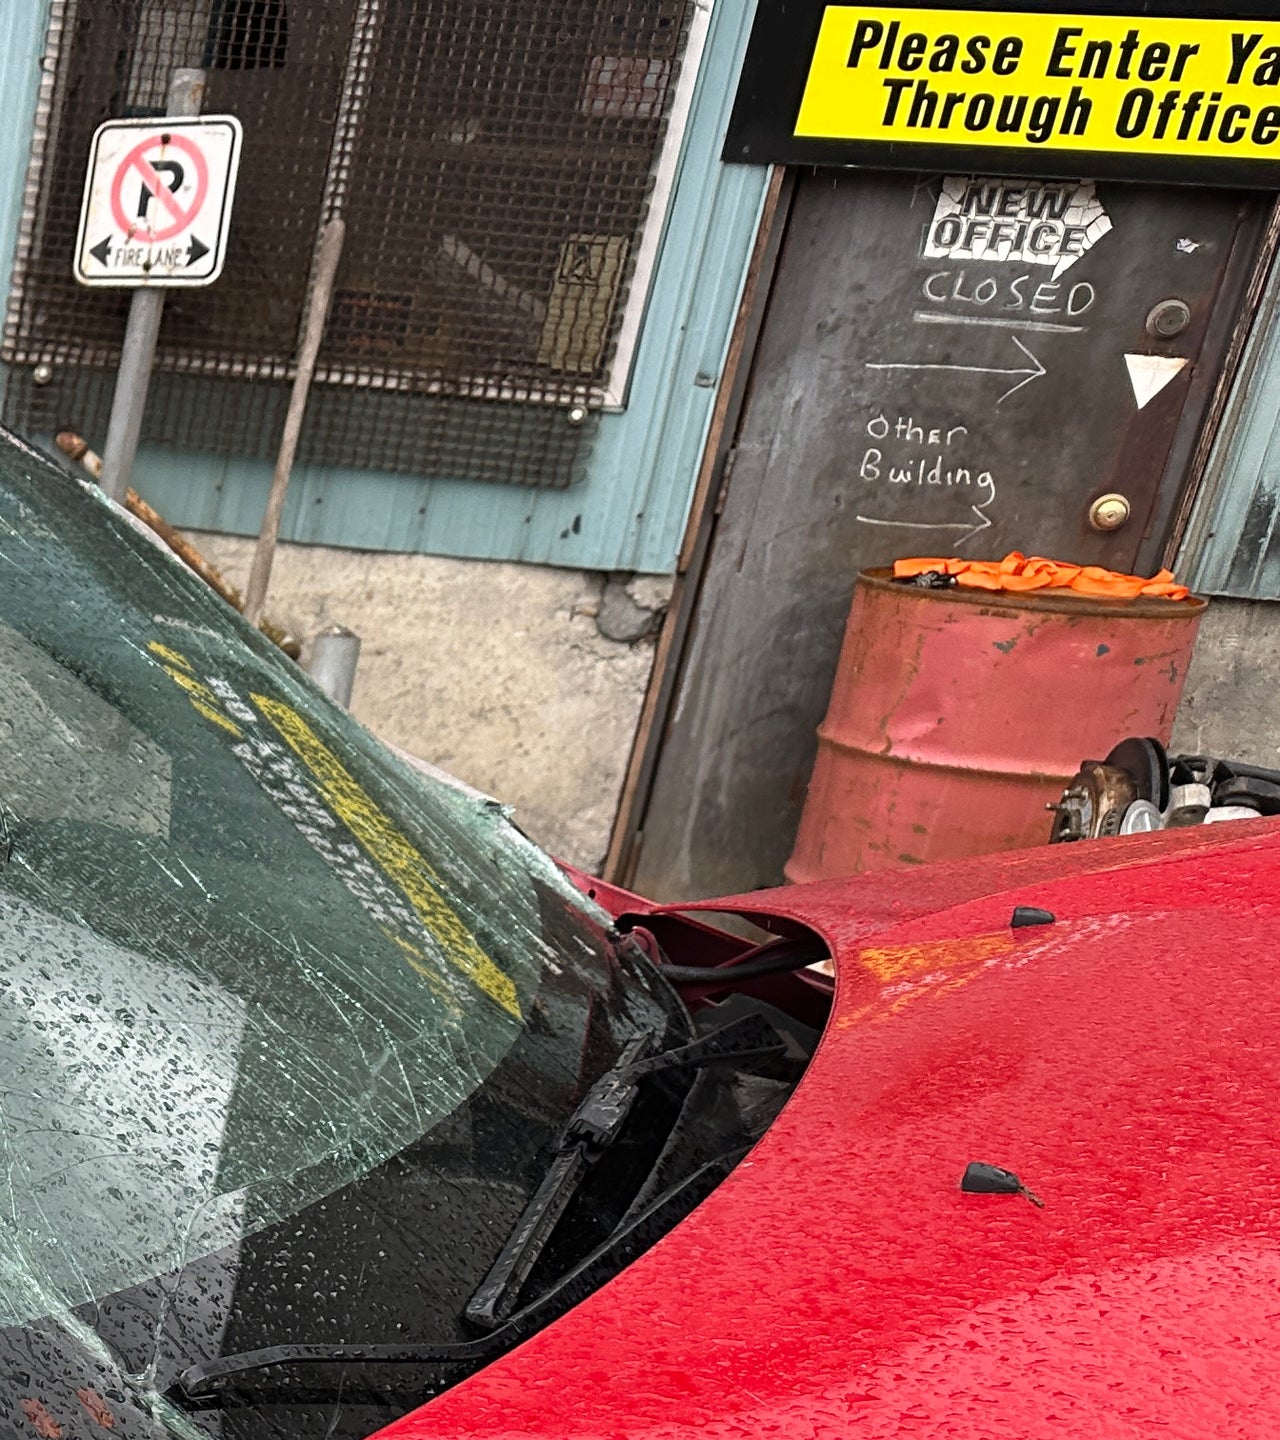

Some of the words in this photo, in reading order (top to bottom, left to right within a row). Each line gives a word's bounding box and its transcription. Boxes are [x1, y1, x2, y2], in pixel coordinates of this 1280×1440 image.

[846, 19, 1024, 76] Please
[1045, 27, 1201, 82] Enter
[1226, 33, 1280, 87] Ya
[881, 77, 1093, 144] Through
[1115, 87, 1280, 145] Office
[960, 183, 1074, 220] NEW
[114, 247, 144, 267] FIRE
[932, 215, 1089, 255] OFFICE
[922, 270, 1096, 316] CLOSED
[859, 448, 996, 508] Building
